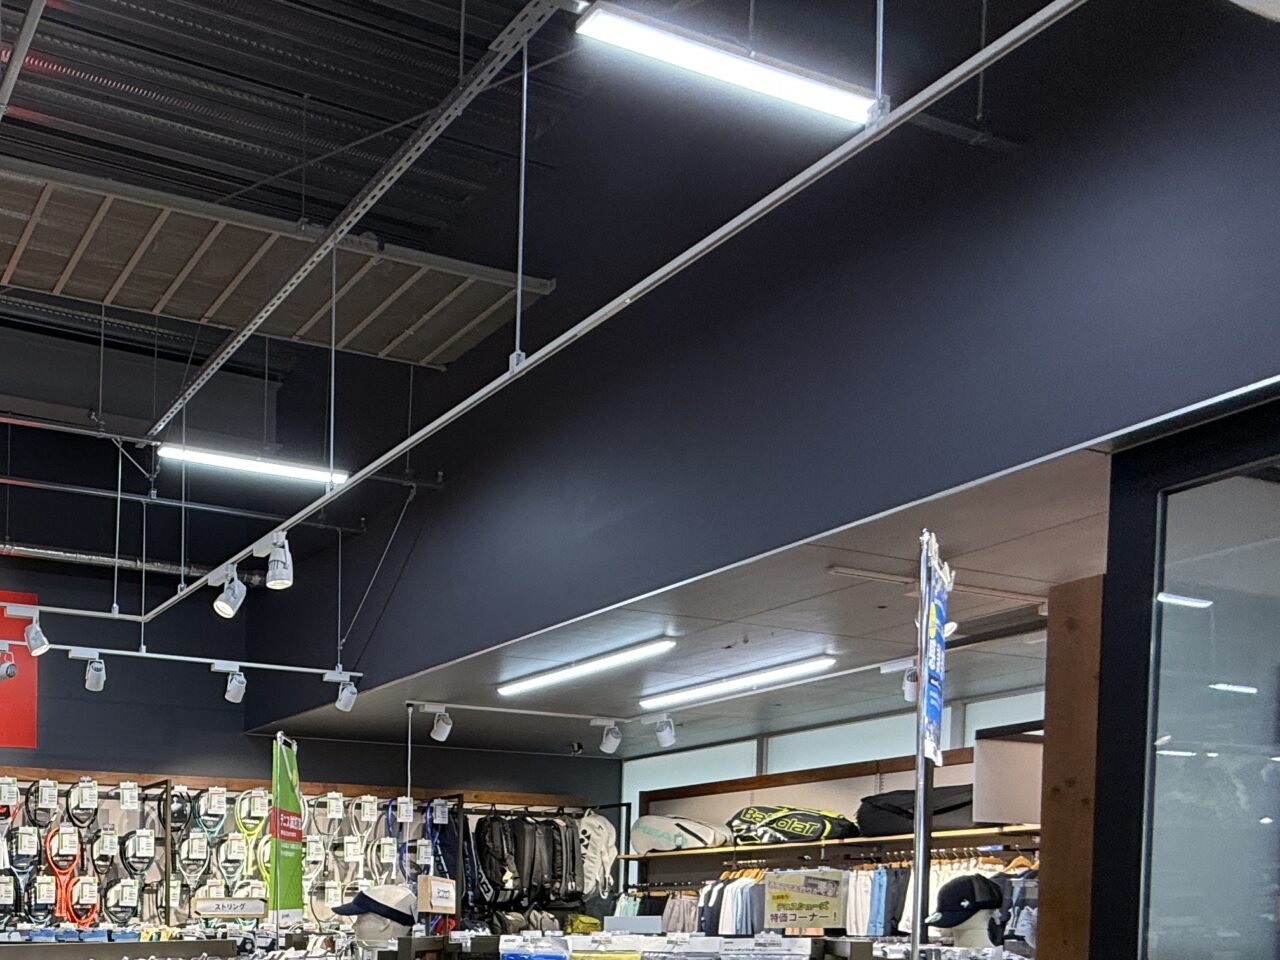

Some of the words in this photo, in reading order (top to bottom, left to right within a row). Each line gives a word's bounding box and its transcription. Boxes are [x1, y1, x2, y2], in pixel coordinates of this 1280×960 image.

[741, 806, 820, 837] Baolat
[214, 903, 246, 911] ストリング
